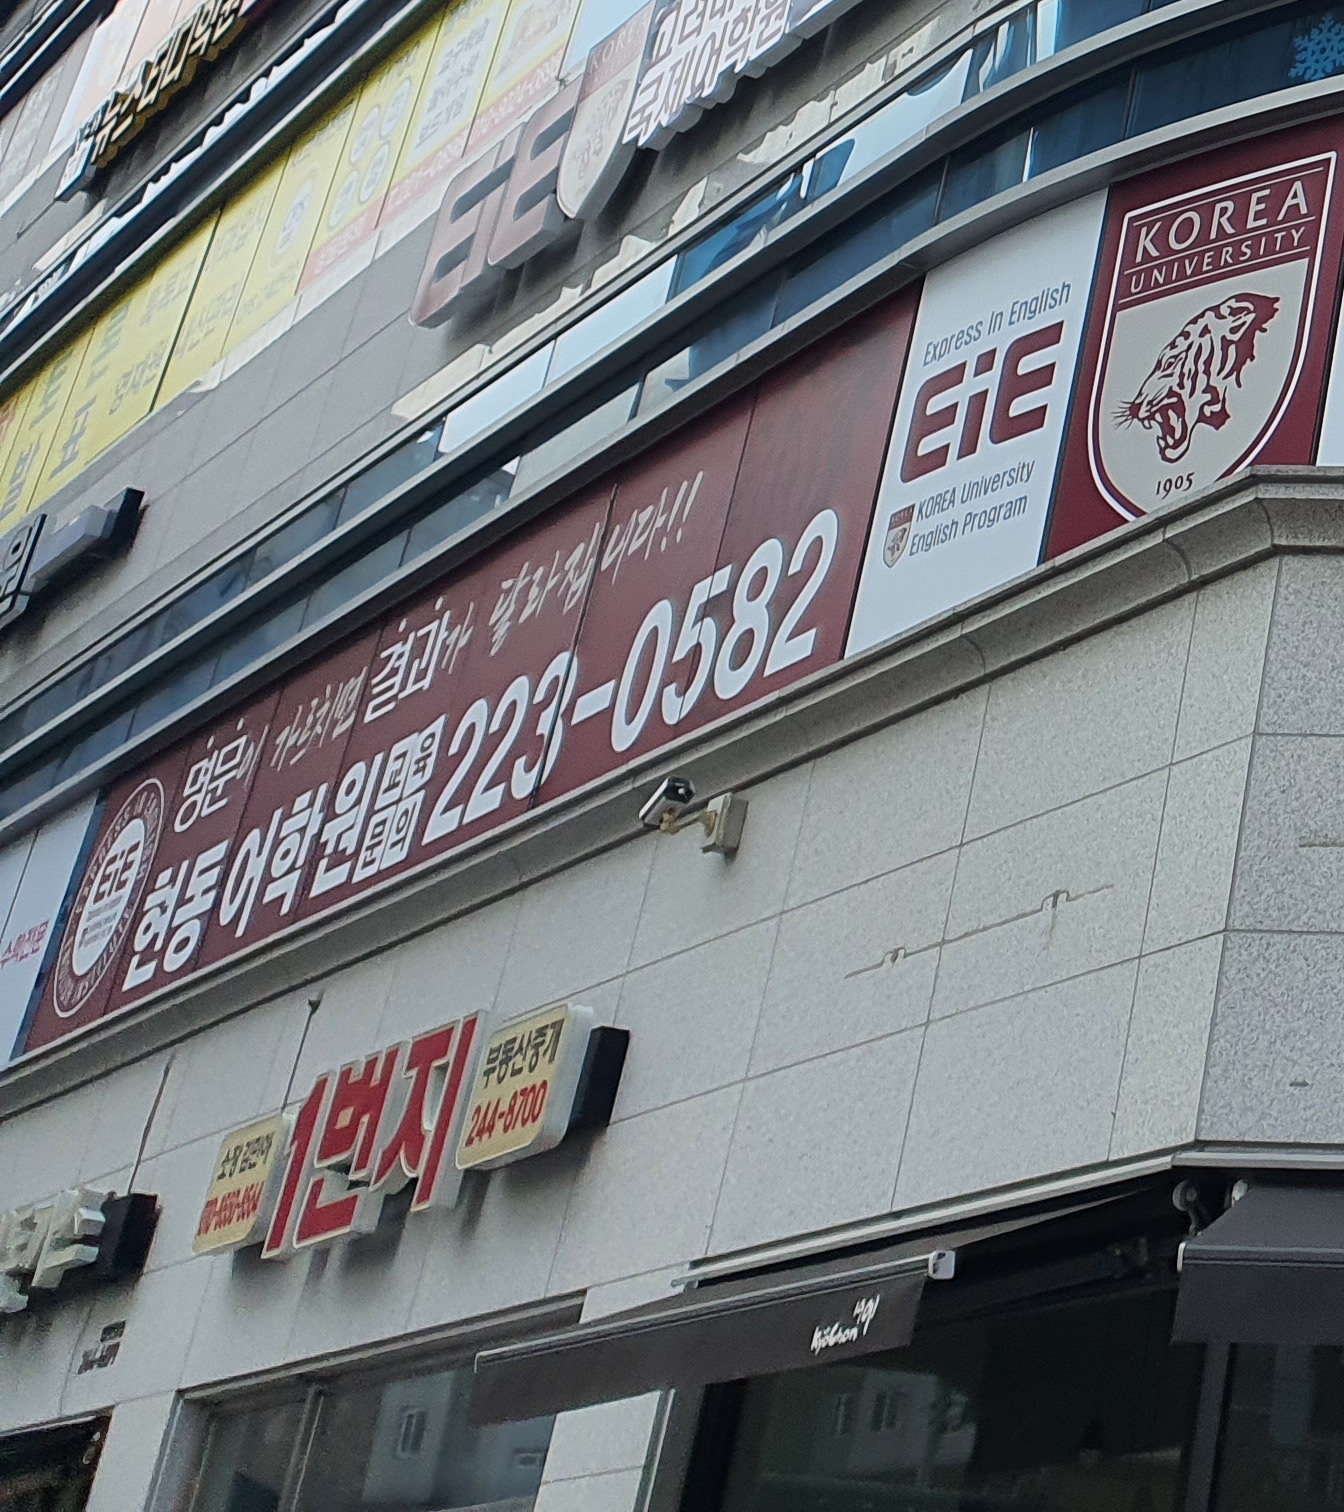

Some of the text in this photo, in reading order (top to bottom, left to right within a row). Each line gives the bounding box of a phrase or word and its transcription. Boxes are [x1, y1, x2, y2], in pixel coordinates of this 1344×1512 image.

[1130, 226, 1306, 293] UNIVERSITY
[1135, 180, 1309, 264] KOREA
[923, 281, 1071, 366] Express In English
[900, 320, 1065, 484] EiE
[908, 494, 1028, 557] English Program
[916, 459, 1036, 522] KOREA University
[1155, 472, 1195, 497] 1905
[422, 508, 839, 846] 223-0582
[122, 750, 386, 993] 현동어학원
[267, 1015, 478, 1253] 1번지
[463, 1078, 549, 1148] 244-8700
